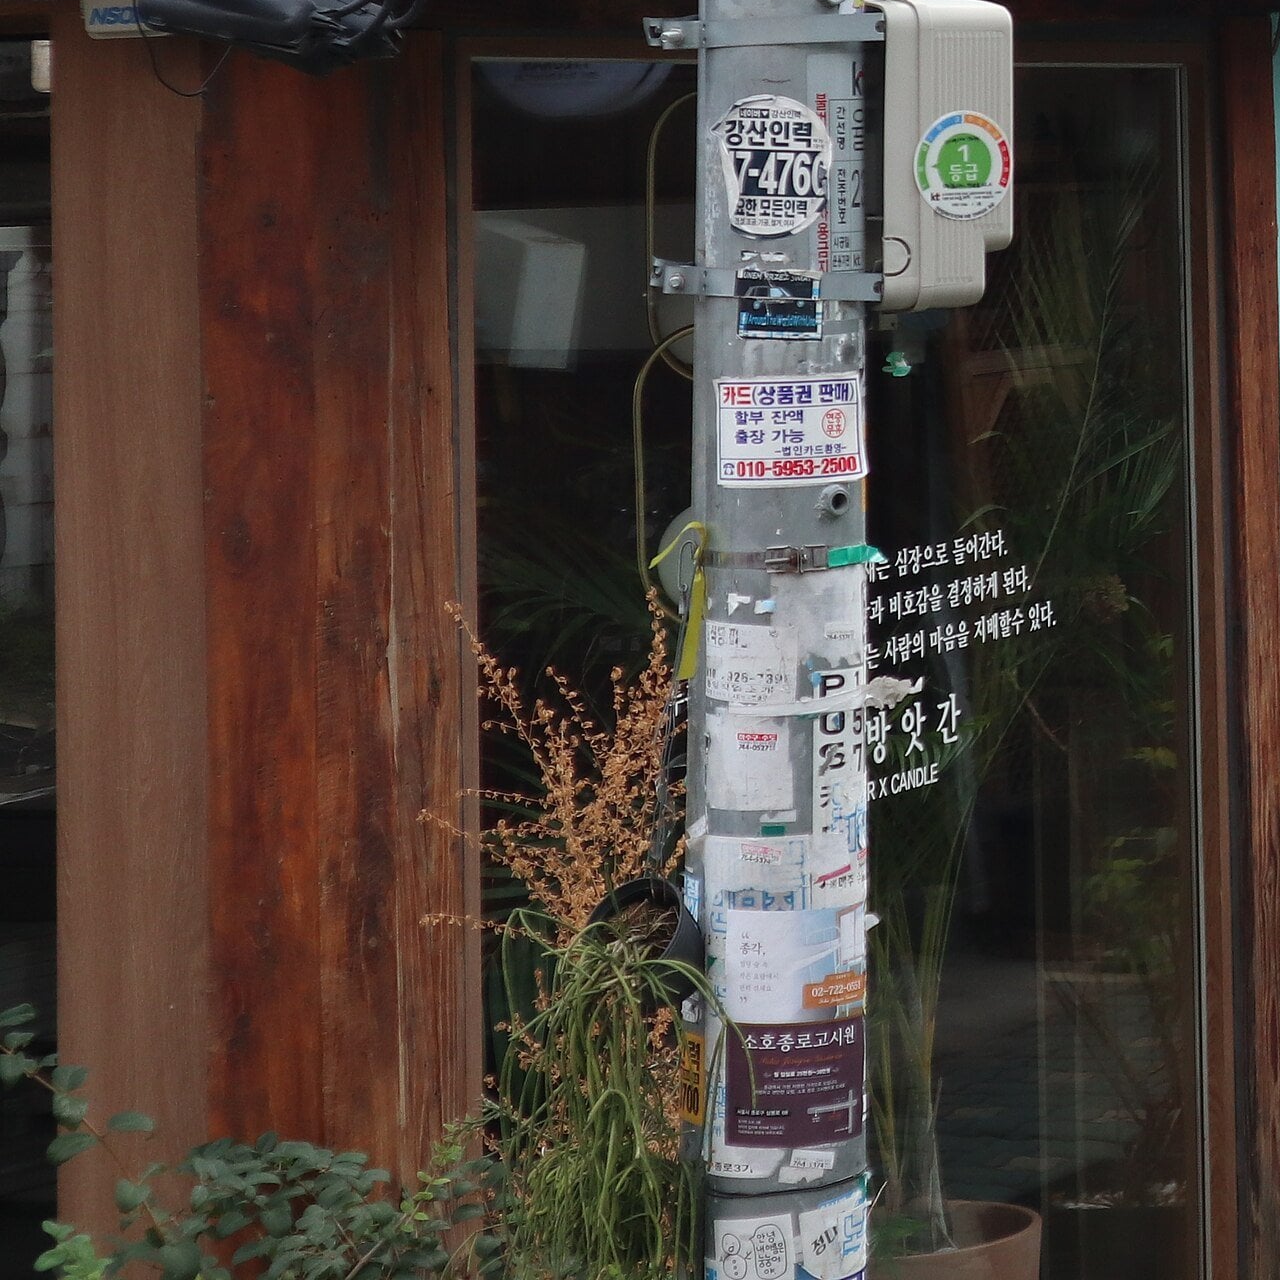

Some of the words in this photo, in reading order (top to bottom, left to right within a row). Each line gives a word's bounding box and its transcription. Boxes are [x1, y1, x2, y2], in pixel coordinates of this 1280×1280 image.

[725, 120, 812, 148] 강산인력
[957, 144, 970, 163] 1
[949, 163, 978, 183] 등급
[759, 198, 808, 219] 모든인력
[723, 384, 812, 406] 카드(상품권
[818, 382, 854, 403] 판매)
[735, 410, 765, 426] 할부
[771, 409, 804, 425] 잔액
[735, 429, 765, 445] 출장
[771, 429, 804, 444] 가능
[736, 456, 858, 478] 010-5953-2500
[895, 543, 950, 576] 심장으로
[952, 529, 1009, 565] 들어간다.
[889, 584, 943, 620] 비호감을
[947, 571, 998, 608] 결정하게
[1002, 565, 1032, 595] 된다.
[884, 629, 925, 666] 사람의
[929, 621, 970, 655] 마음을
[974, 608, 1025, 644] 지배할수
[1029, 600, 1057, 632] 있다.
[879, 777, 888, 799] X
[891, 763, 940, 795] CANDLE
[743, 1024, 855, 1053] 소호종로고시원
[756, 1231, 776, 1244] 안녕
